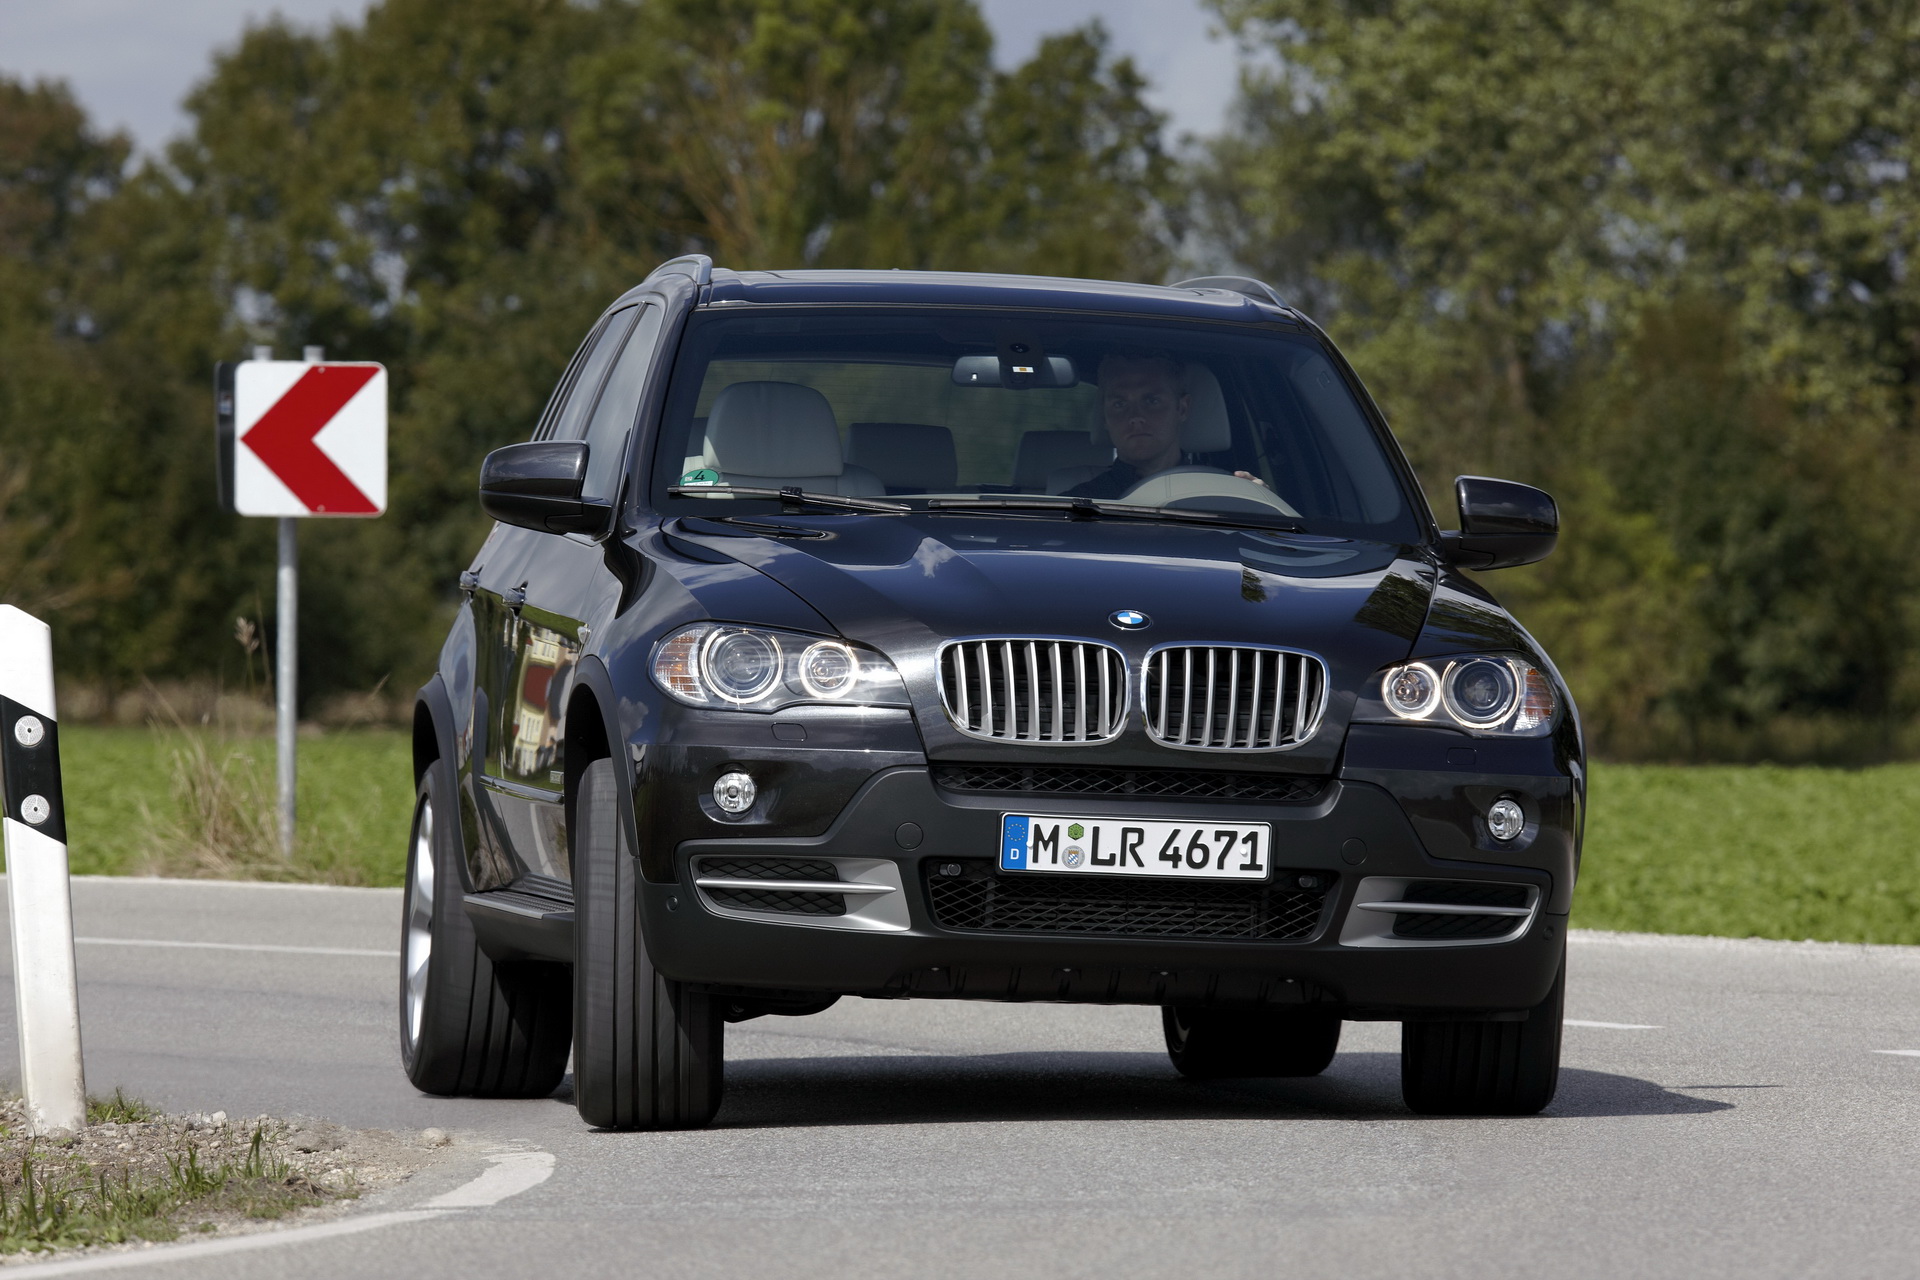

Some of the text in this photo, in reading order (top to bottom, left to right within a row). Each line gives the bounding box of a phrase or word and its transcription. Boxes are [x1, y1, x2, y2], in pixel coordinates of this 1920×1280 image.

[694, 470, 705, 481] 4
[1032, 823, 1264, 871] M LR 4671
[1010, 848, 1020, 860] D
